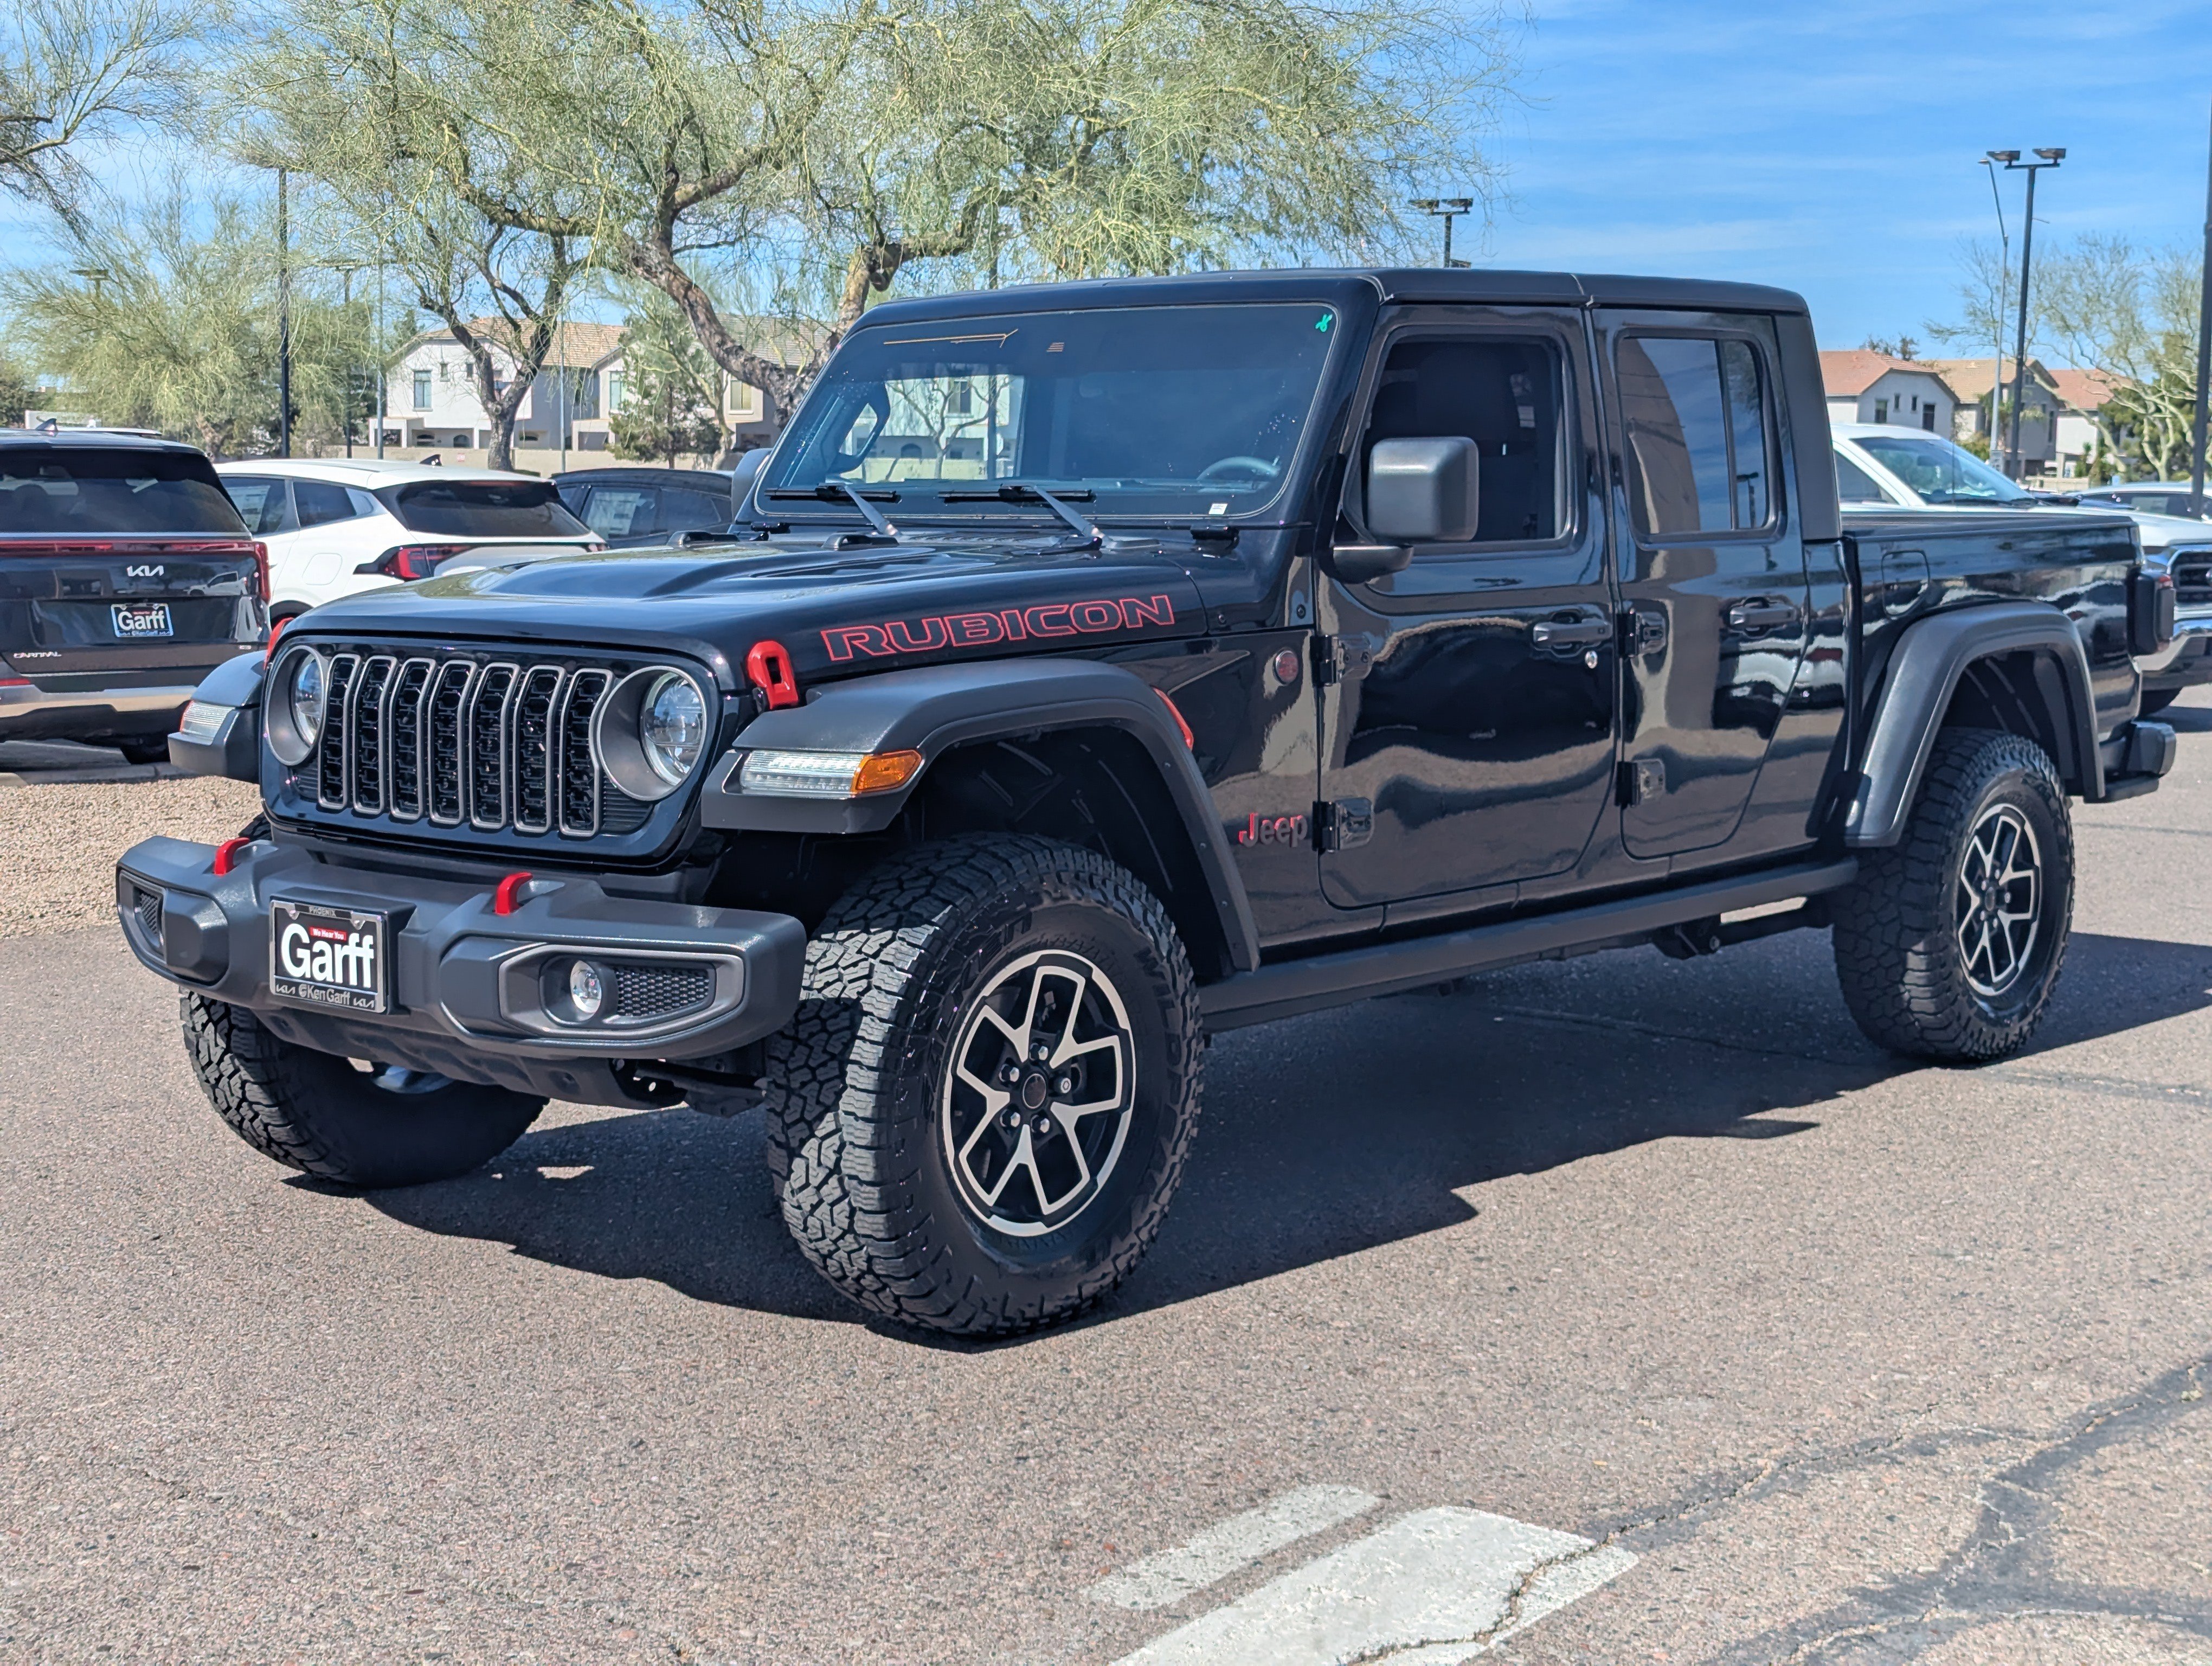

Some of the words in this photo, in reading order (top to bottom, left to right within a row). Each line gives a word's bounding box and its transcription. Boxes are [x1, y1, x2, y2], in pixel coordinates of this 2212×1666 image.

[126, 565, 164, 576] KIA
[118, 611, 165, 630] Garff
[820, 594, 1175, 662] RUBICON
[1238, 812, 1308, 848] Jeep
[309, 906, 336, 917] PHOENIX
[312, 928, 321, 937] We
[321, 930, 334, 938] Hear
[334, 931, 344, 940] You
[281, 923, 375, 989] Garff
[276, 984, 295, 995] KIA
[353, 997, 375, 1009] KIA
